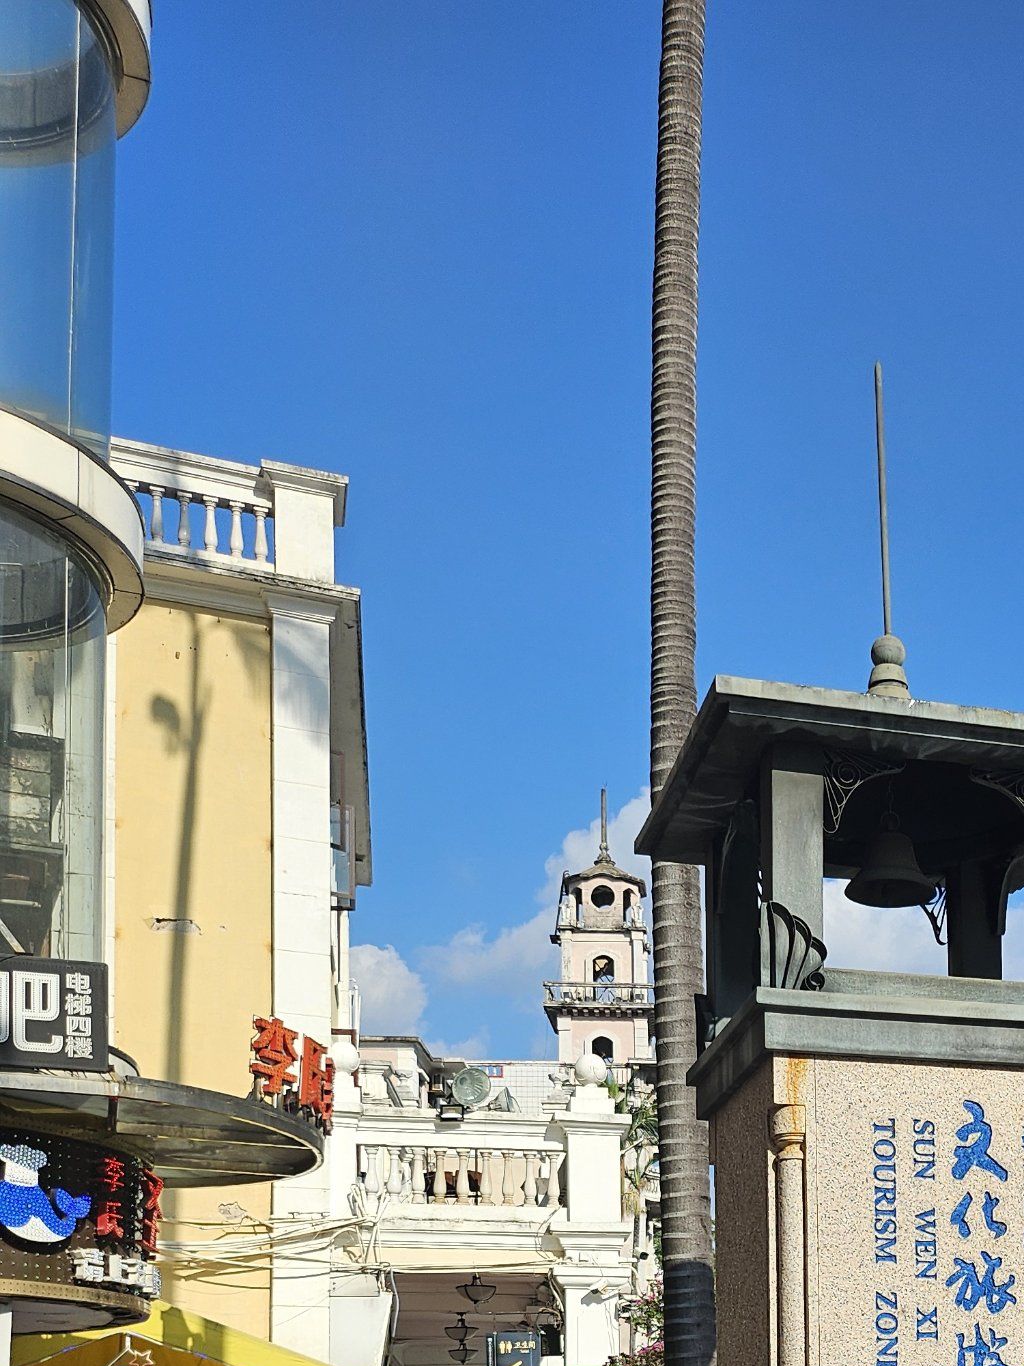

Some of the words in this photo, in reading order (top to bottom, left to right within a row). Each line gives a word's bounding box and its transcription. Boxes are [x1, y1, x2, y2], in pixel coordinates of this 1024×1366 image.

[65, 972, 93, 1059] 电梯四楼
[913, 1118, 936, 1182] SUN
[872, 1118, 898, 1264] TOURISM
[914, 1207, 937, 1281] WEN
[916, 1306, 938, 1342] XI
